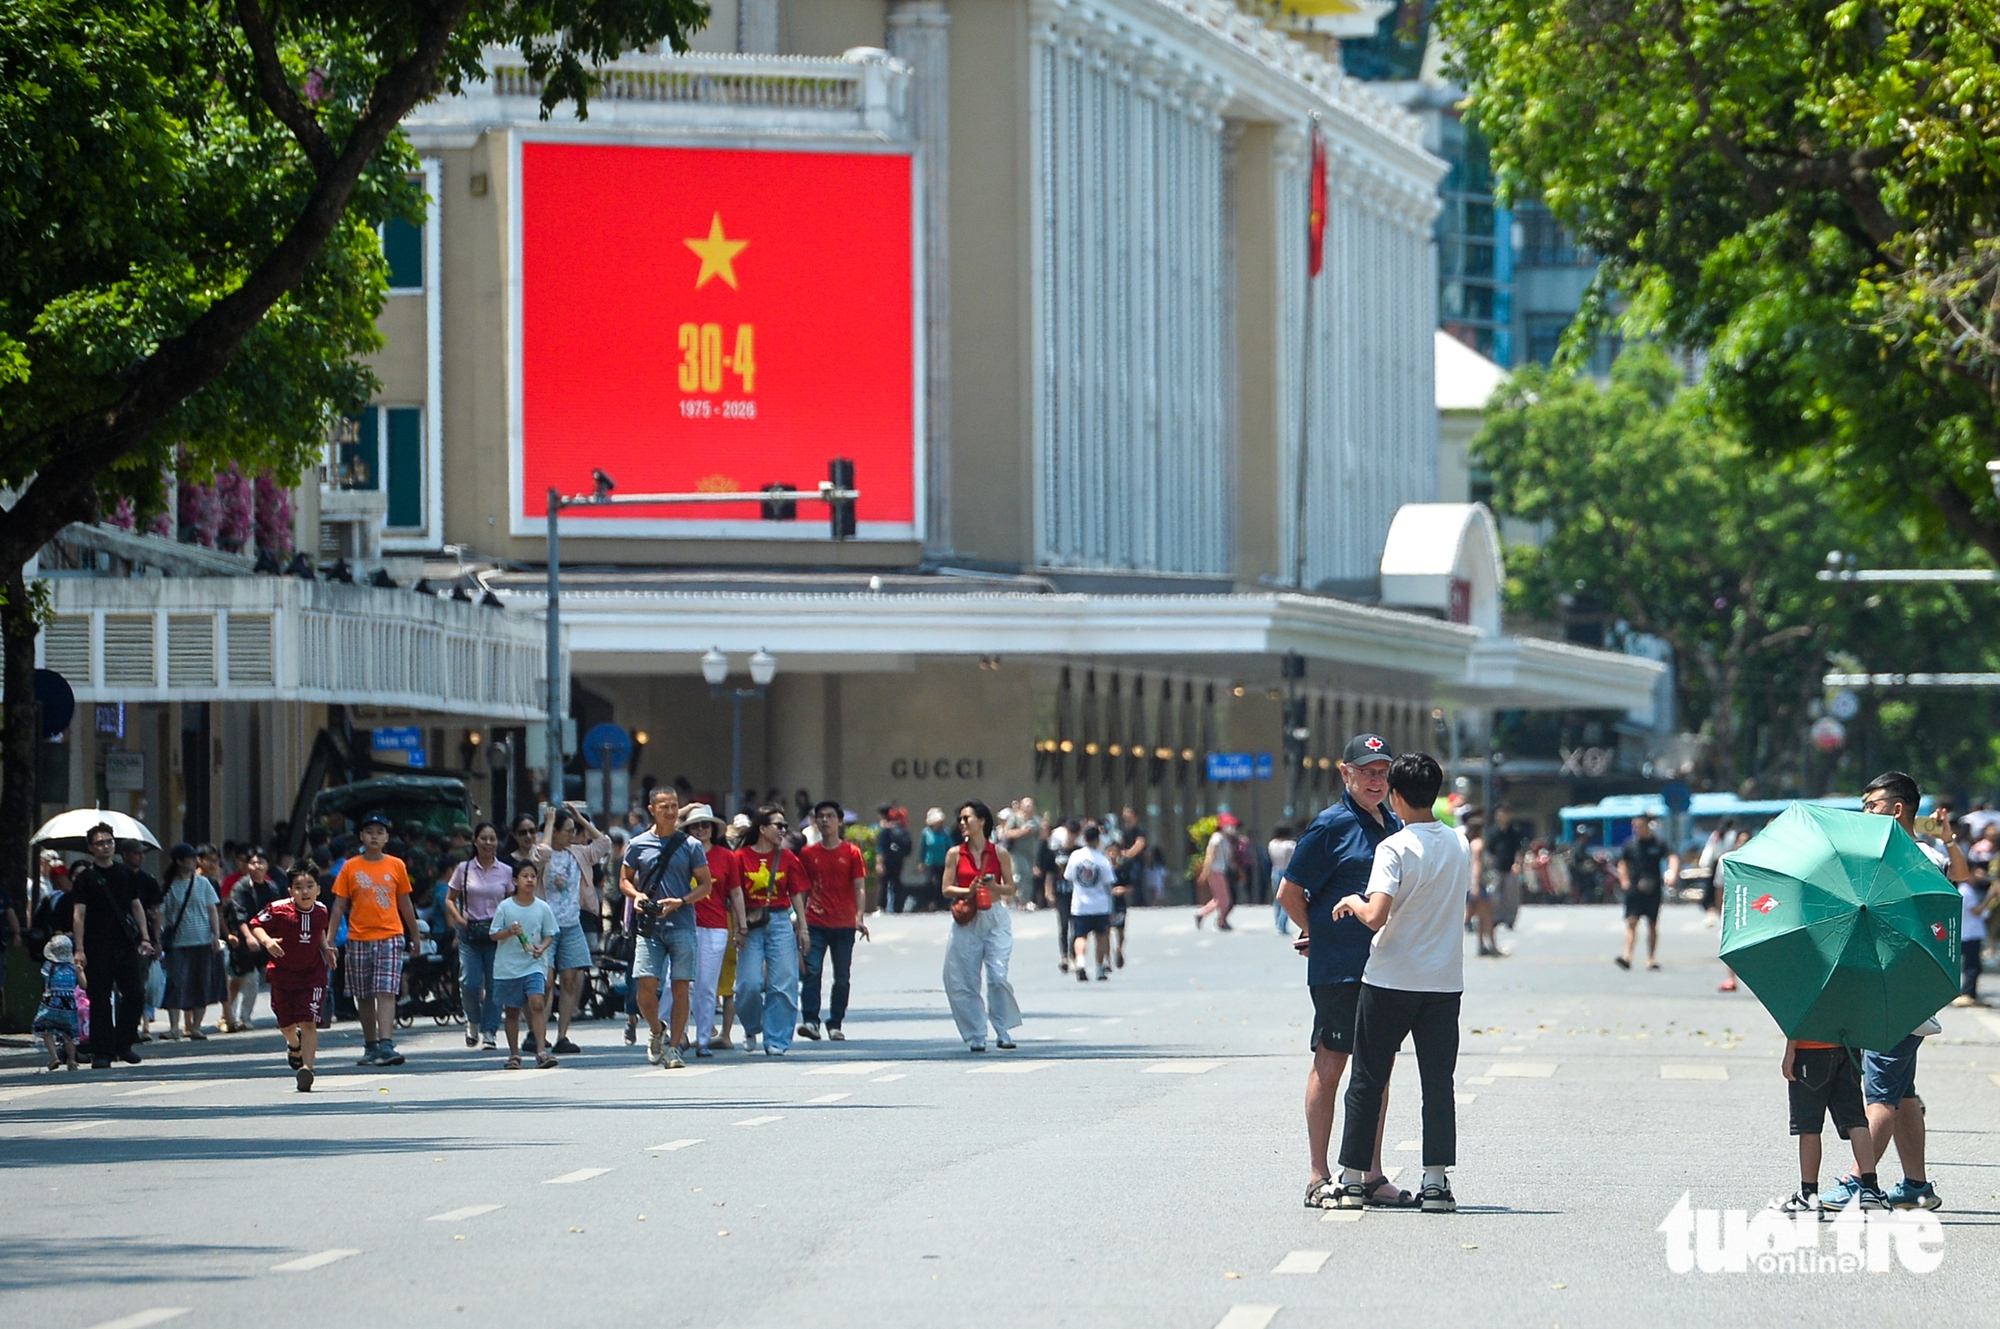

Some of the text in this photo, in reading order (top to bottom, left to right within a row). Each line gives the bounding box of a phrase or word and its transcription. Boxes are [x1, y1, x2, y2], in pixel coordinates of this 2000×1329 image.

[679, 324, 756, 393] 30-4
[680, 400, 711, 418] 1975
[892, 758, 983, 779] GUCCI
